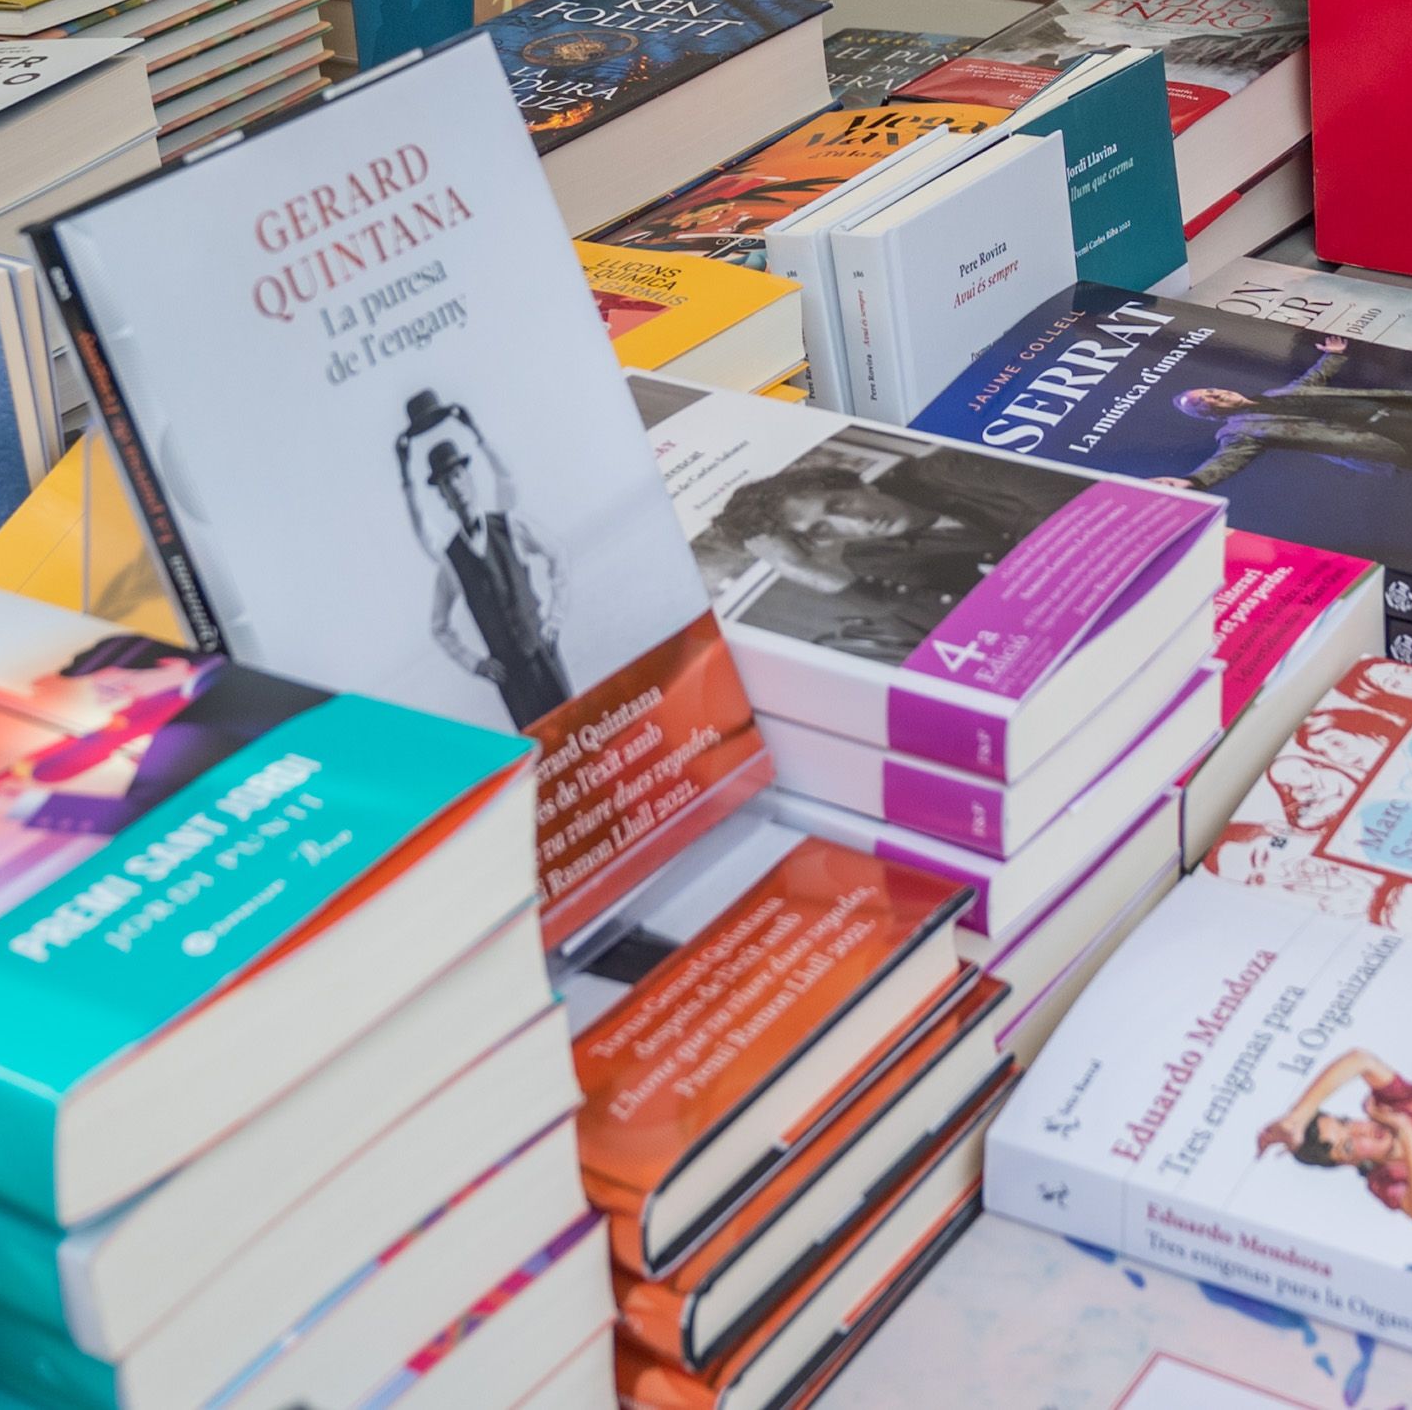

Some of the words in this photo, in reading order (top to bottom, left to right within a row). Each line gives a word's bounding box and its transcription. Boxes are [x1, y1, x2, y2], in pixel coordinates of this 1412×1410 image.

[534, 3, 746, 38] FOLLETT
[253, 141, 432, 255] GERARD
[250, 185, 474, 323] QUINTANA
[362, 259, 450, 321] puresa
[595, 257, 666, 282] LLIÇONS
[958, 256, 981, 282] Pere
[979, 240, 1008, 269] Rovira
[362, 293, 469, 370] l'engany
[953, 285, 985, 310] Avui
[1345, 306, 1383, 336] piano
[967, 356, 1021, 412] JAUME
[1017, 308, 1087, 362] COLLELL
[981, 299, 1176, 454] SERRAT
[1087, 378, 1144, 437] música
[1177, 324, 1217, 365] vida
[1358, 795, 1412, 857] Marc
[1300, 926, 1401, 1051] Organización
[1110, 1048, 1206, 1167] Eduardo
[1197, 947, 1278, 1056] Mendoza
[1182, 1033, 1275, 1140] enigmas
[1156, 1128, 1218, 1183] Tres
